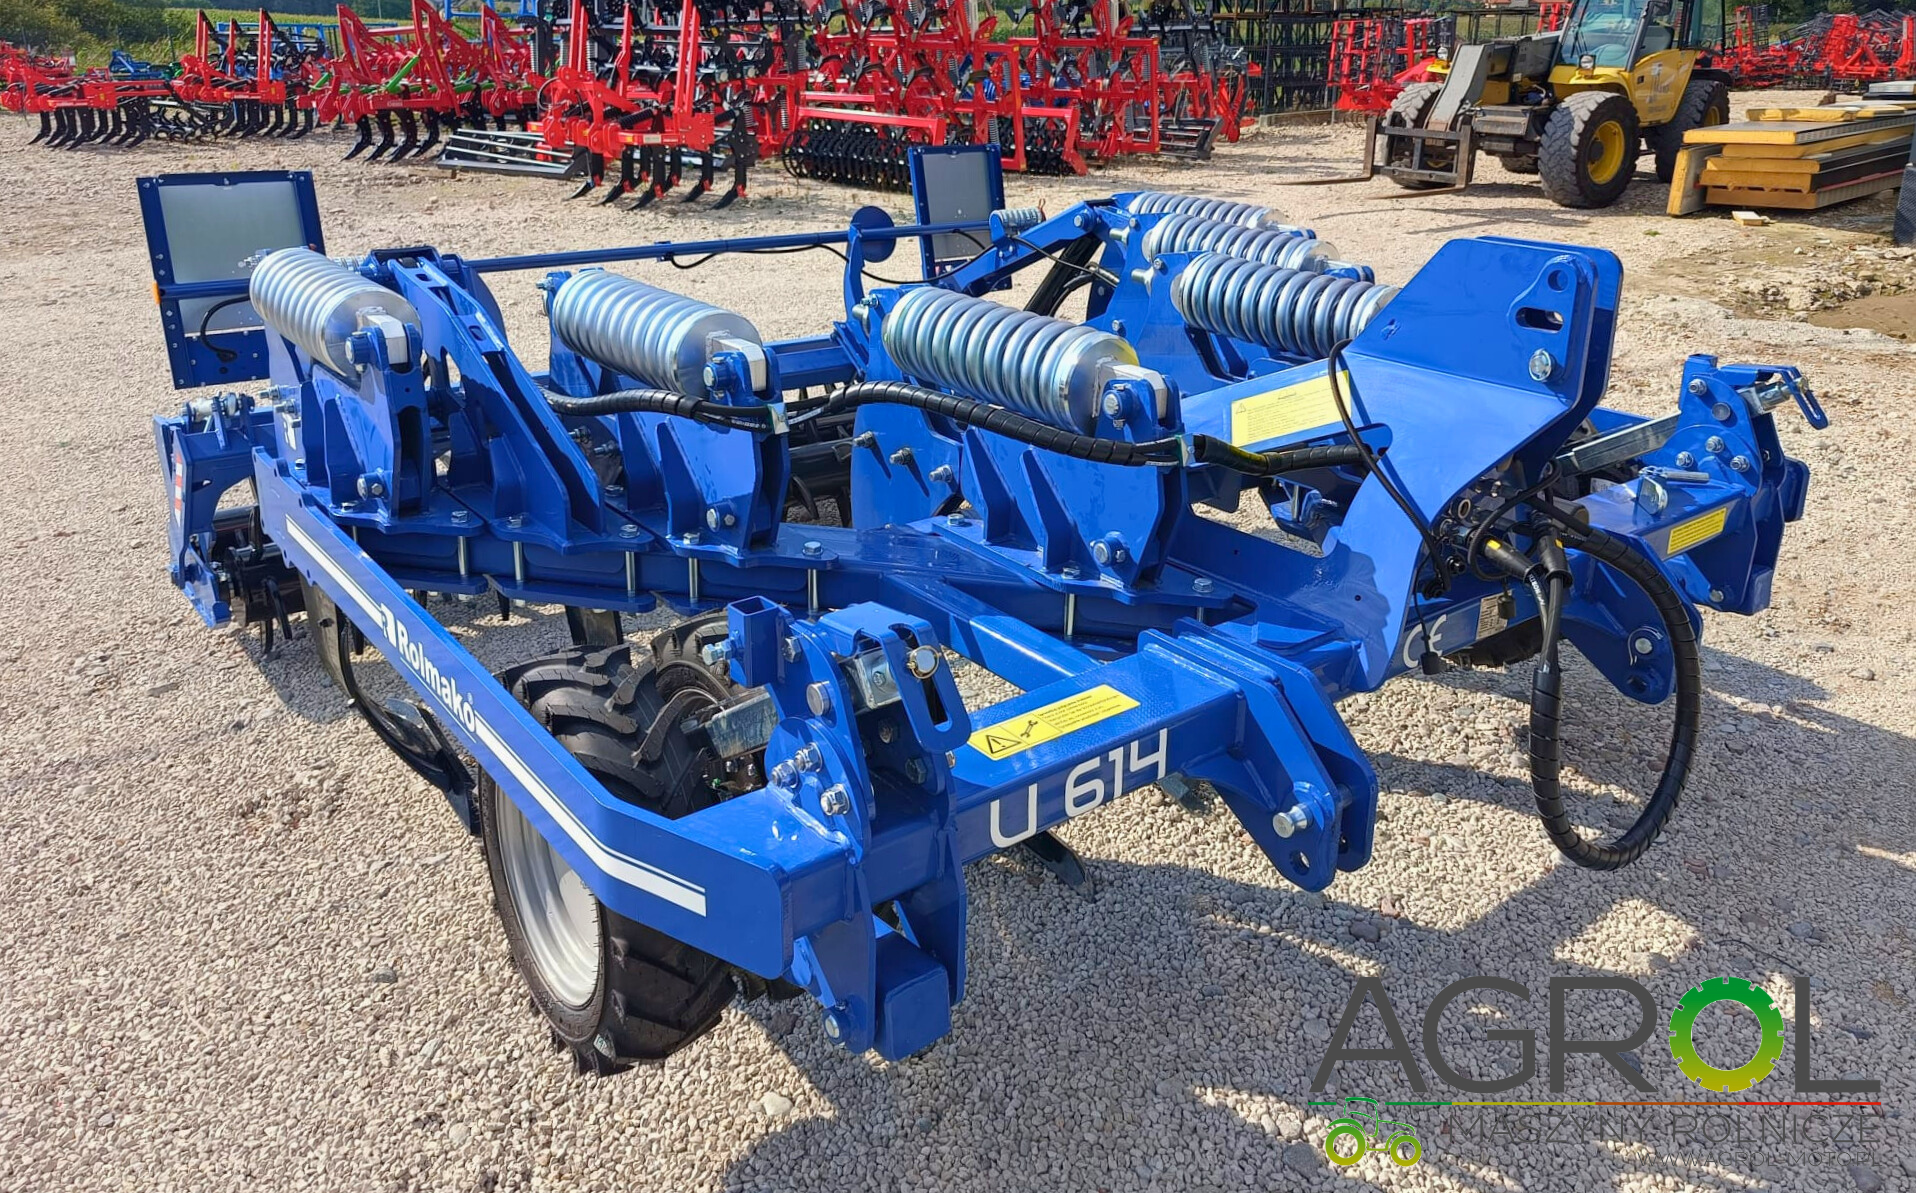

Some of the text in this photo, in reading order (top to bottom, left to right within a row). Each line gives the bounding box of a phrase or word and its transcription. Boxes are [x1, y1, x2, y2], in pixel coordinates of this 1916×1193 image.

[1403, 614, 1447, 668] CE
[990, 728, 1168, 848] U 614
